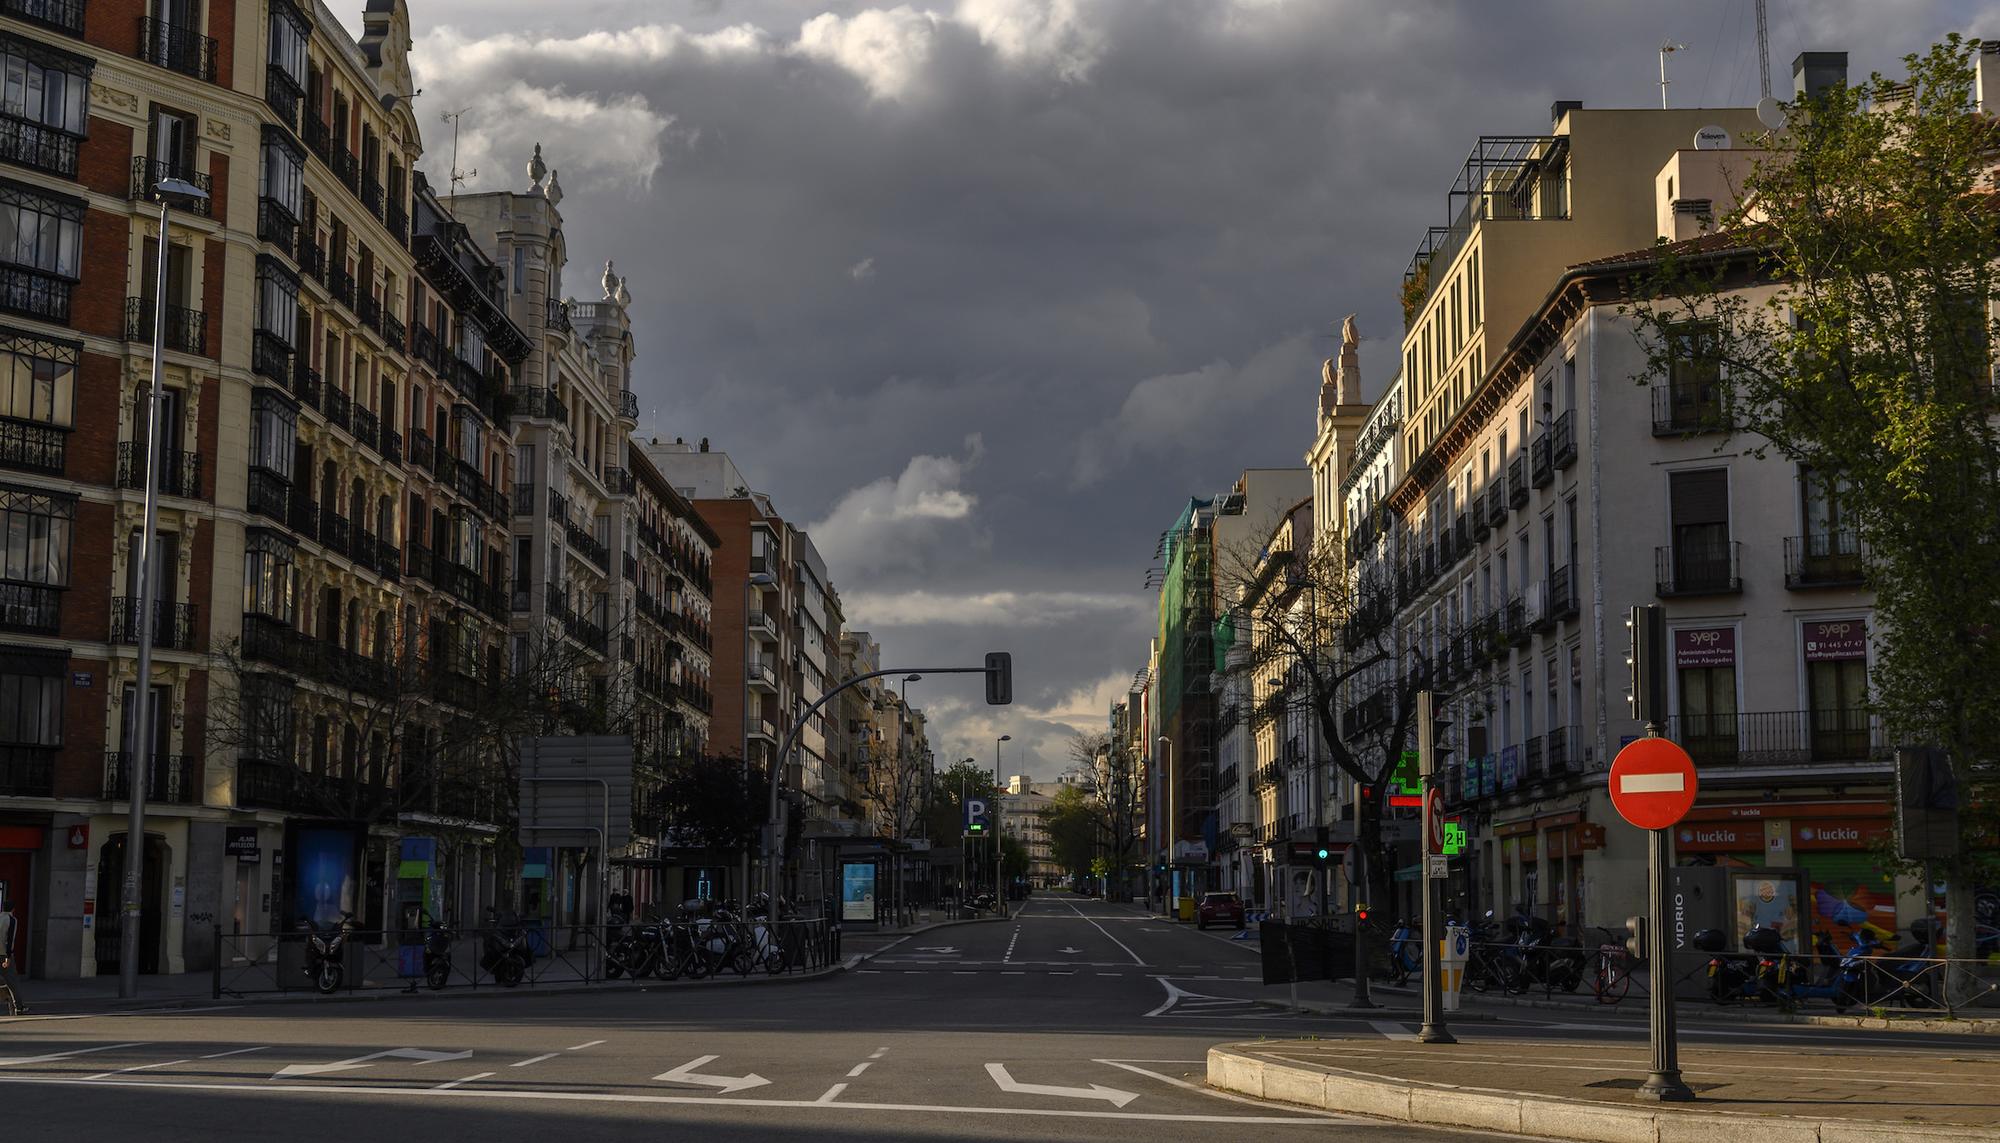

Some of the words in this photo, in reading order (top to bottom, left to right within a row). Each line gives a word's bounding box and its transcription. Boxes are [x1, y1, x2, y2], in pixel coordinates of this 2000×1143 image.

[1819, 623, 1850, 639] syep
[1690, 631, 1720, 646] syep
[1819, 641, 1827, 649] 91
[1701, 657, 1733, 665] Abogados
[968, 800, 985, 824] P
[1740, 808, 1761, 816] luckia
[1696, 830, 1736, 843] luckia
[1817, 827, 1858, 841] luckia
[1675, 893, 1685, 949] VIDRIO
